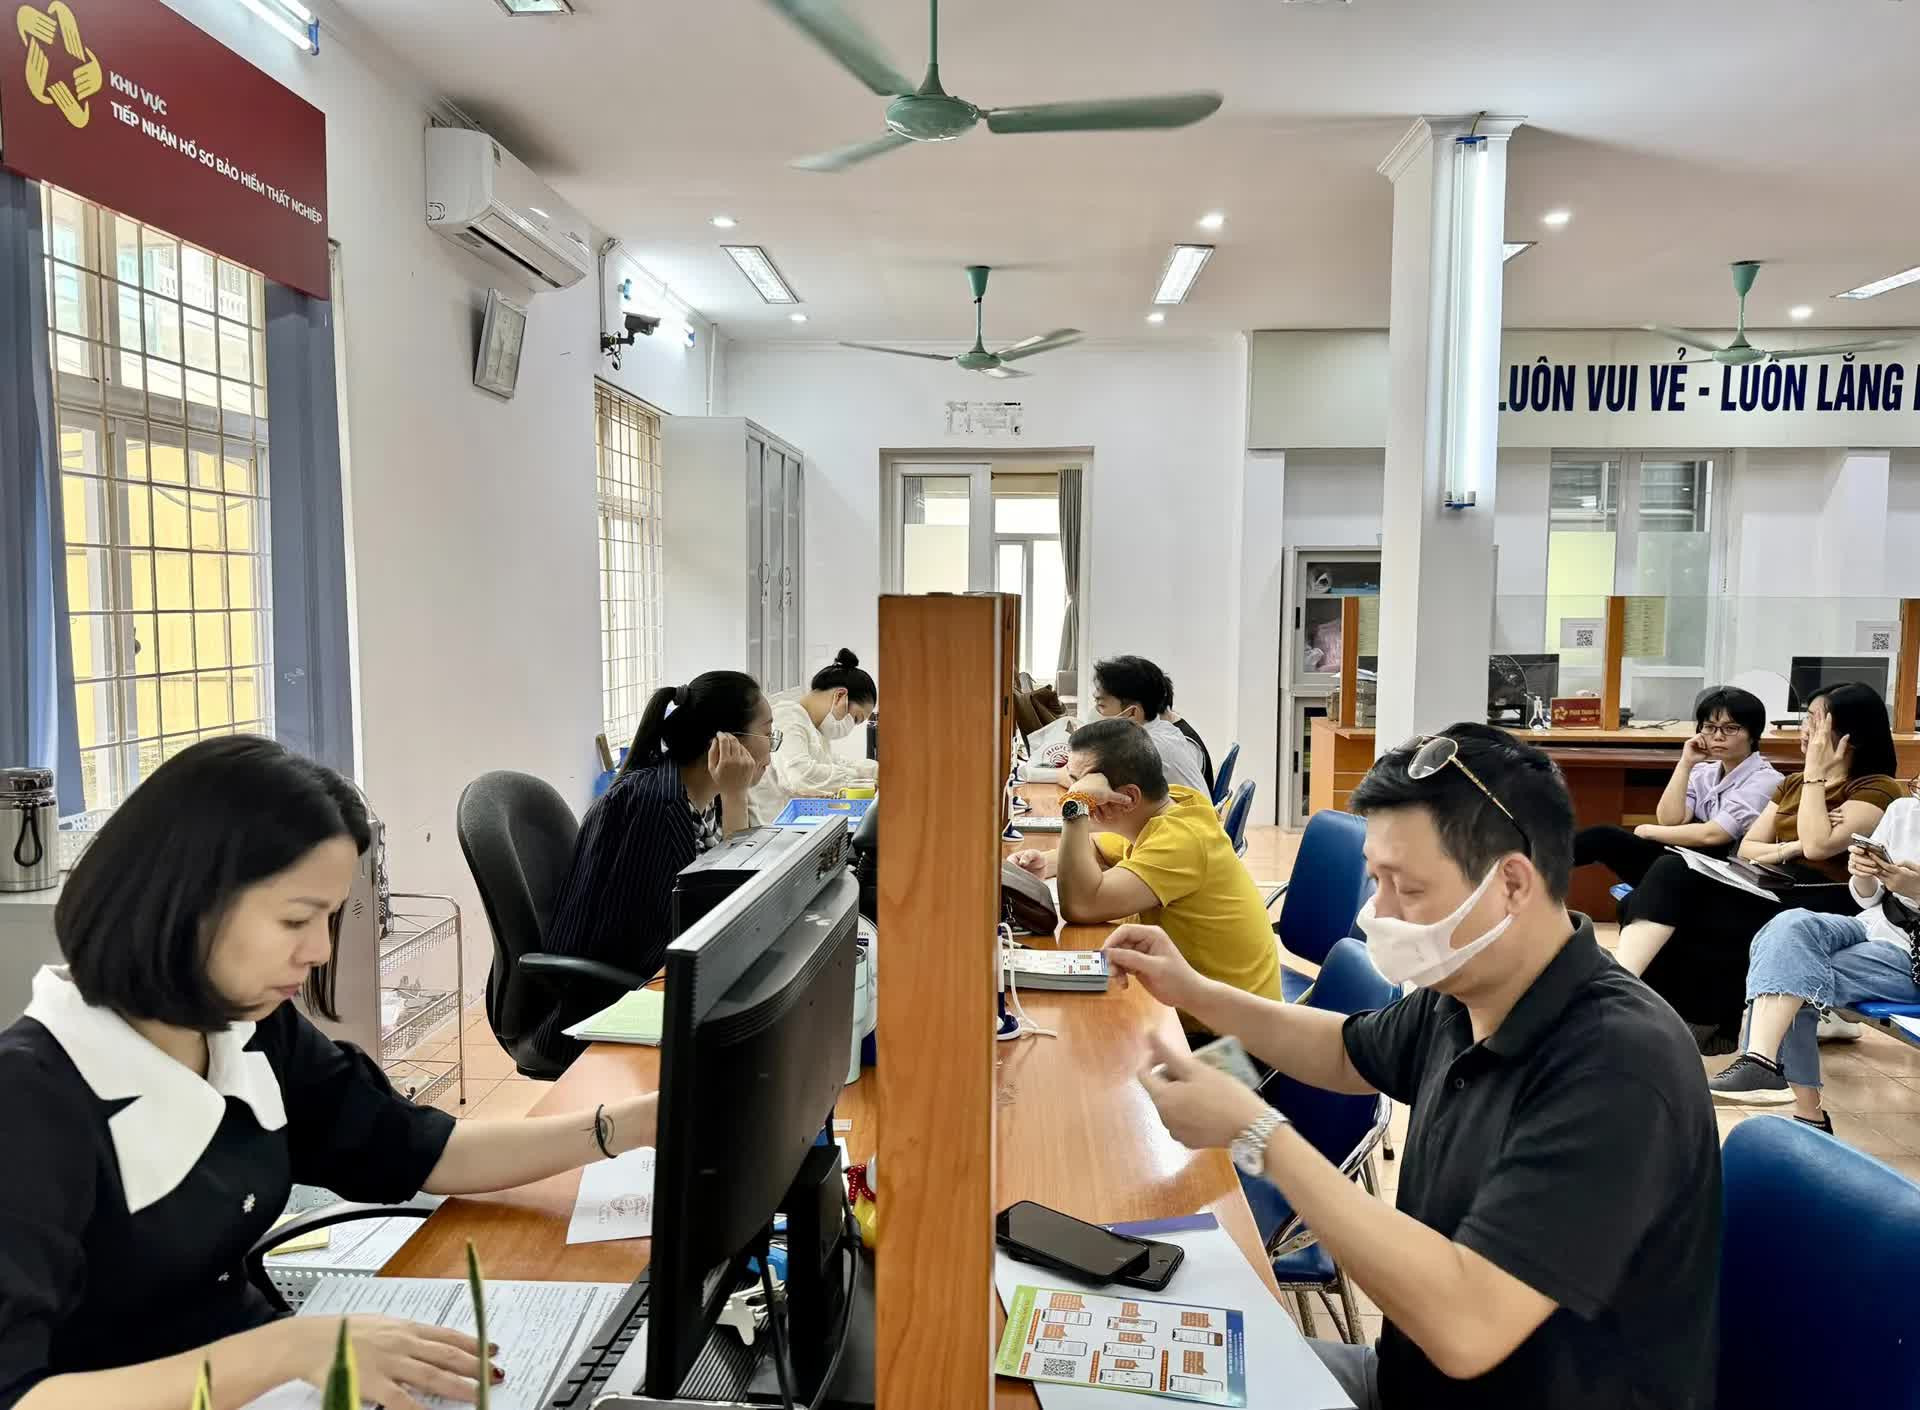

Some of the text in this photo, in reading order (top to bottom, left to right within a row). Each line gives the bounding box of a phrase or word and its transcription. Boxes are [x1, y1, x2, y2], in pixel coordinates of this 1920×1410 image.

[110, 70, 167, 115] KHU VỰC
[110, 100, 322, 224] TIẾP NHẬN HỒ SƠ BẢO HIỂM THẤT NGHIỆP
[1499, 356, 1576, 411] UÔN
[1587, 365, 1638, 411] VUI
[1650, 347, 1688, 411] VẺ
[1721, 357, 1808, 411] LUÔN
[1816, 352, 1904, 412] LẮNG
